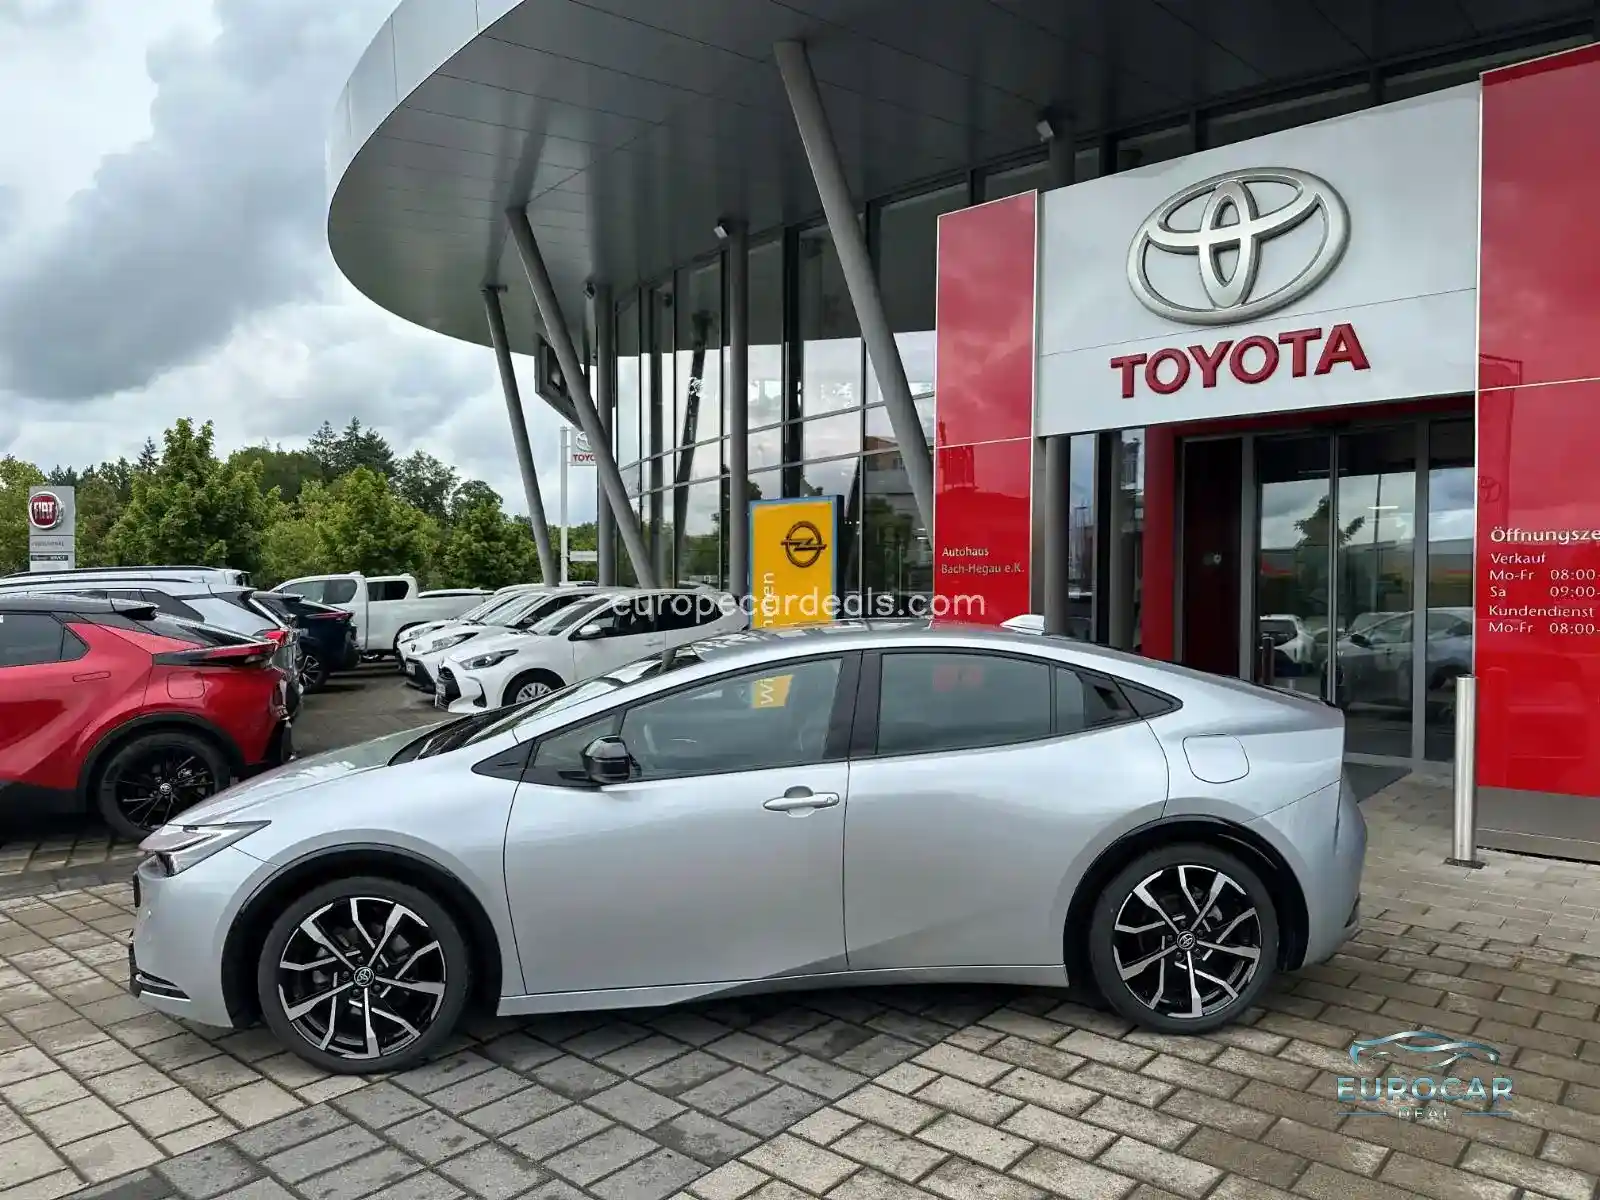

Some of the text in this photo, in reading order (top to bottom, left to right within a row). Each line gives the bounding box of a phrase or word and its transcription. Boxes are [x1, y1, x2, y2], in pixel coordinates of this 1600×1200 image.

[1110, 323, 1371, 399] TOYOTA
[33, 501, 55, 520] FIAT
[1490, 526, 1600, 545] Öffnungsze
[941, 546, 989, 557] Autohaus
[1491, 552, 1546, 564] Verkauf
[941, 562, 1025, 576] Bach-Hegau e.K.
[1489, 569, 1535, 580] Mo-Fr
[1490, 586, 1506, 597] Sa
[1489, 605, 1594, 617] Kundendienst
[1488, 622, 1534, 633] Mo-Fr
